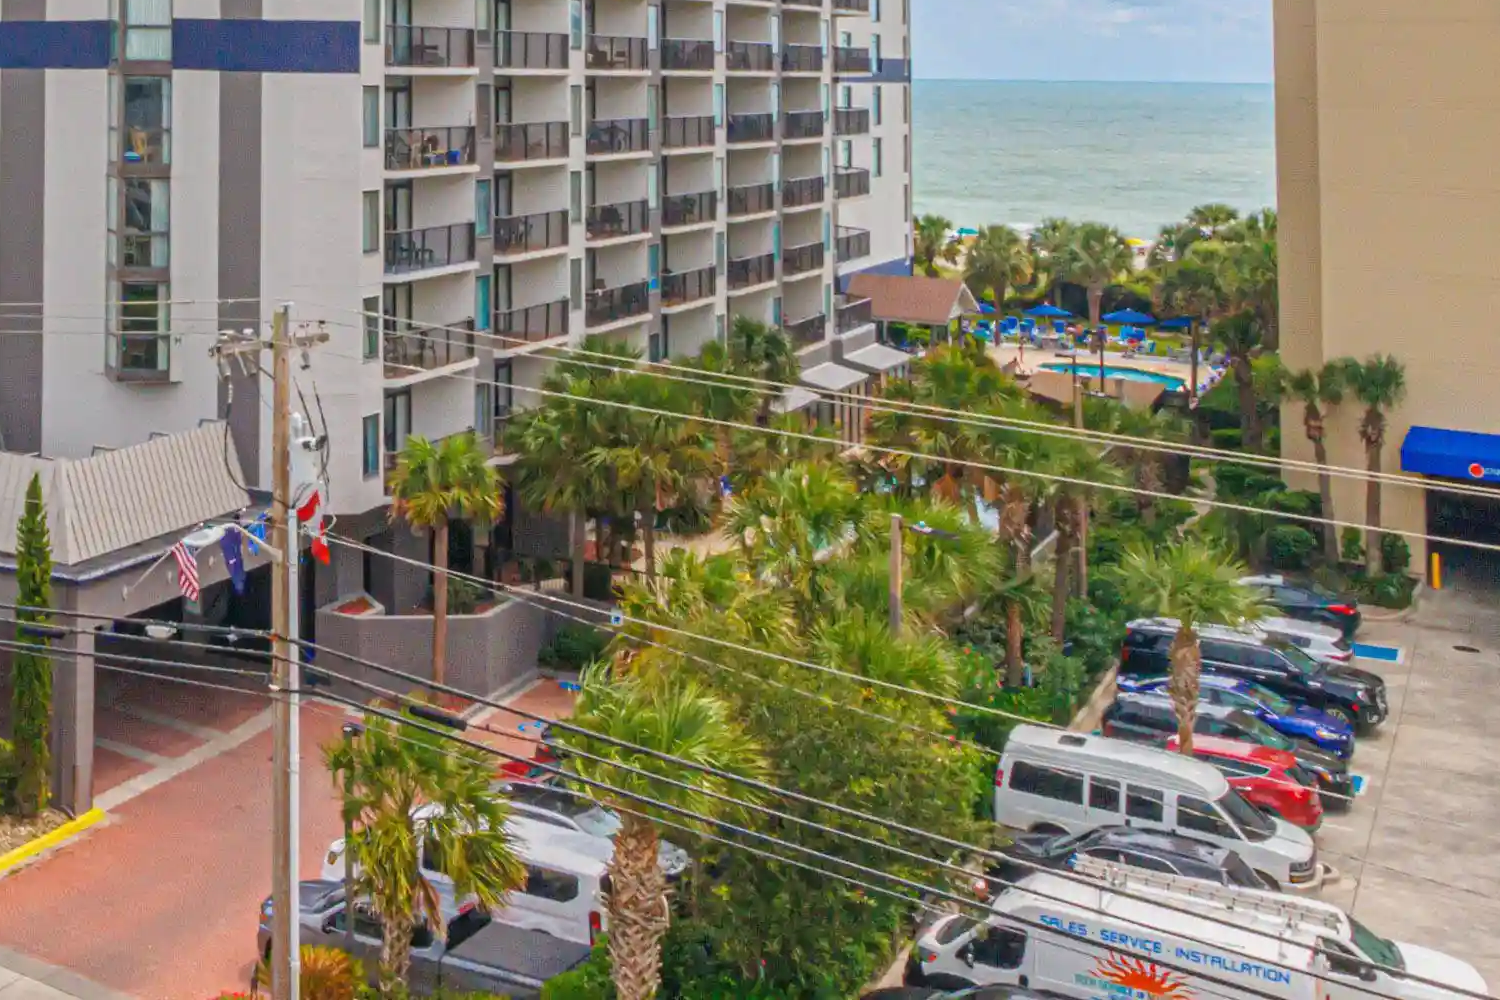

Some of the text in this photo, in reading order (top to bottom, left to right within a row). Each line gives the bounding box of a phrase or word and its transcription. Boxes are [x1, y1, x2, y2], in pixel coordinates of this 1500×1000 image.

[1039, 914, 1291, 985] SALES SERVICE INSTALLATION
